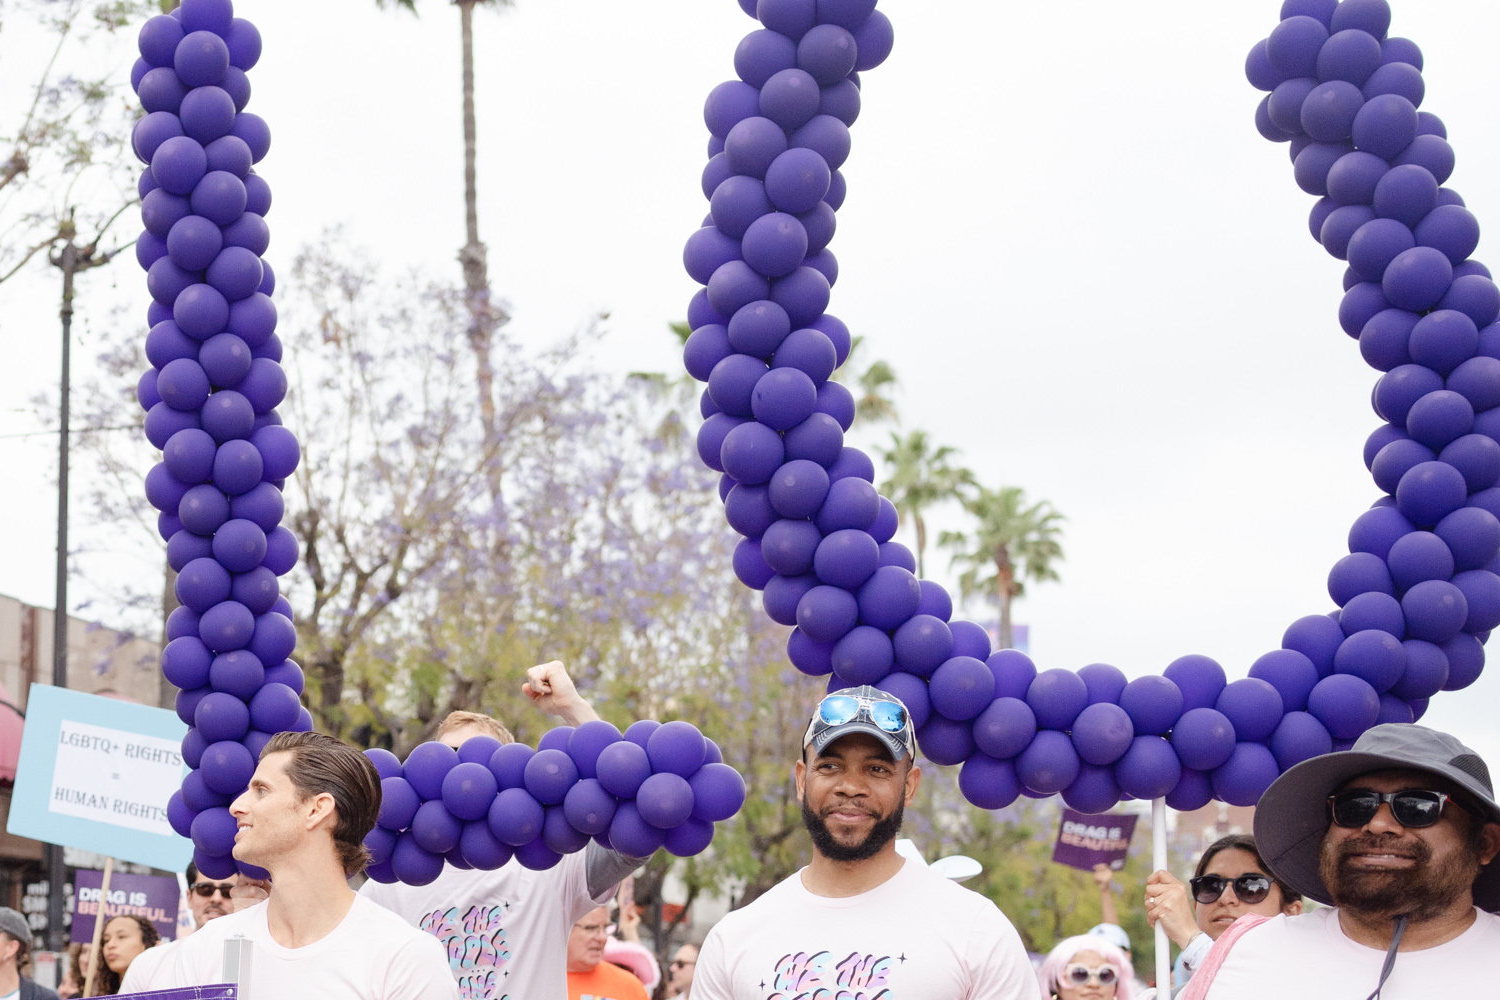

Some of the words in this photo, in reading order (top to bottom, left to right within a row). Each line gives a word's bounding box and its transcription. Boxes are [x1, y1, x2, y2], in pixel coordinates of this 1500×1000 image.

[60, 730, 120, 755] LGBTQ+
[124, 743, 182, 767] RIGHTS
[54, 787, 109, 810] HUMAN
[112, 799, 168, 823] RIGHTS
[1063, 821, 1108, 840] DRAG
[77, 901, 174, 923] BEAUTIFUL.
[78, 887, 127, 905] DRAG
[129, 891, 147, 907] IS
[462, 905, 502, 935] THE
[443, 929, 512, 970] OPLE
[459, 970, 498, 1000] ANS
[774, 951, 834, 992] WE
[835, 951, 894, 990] THE
